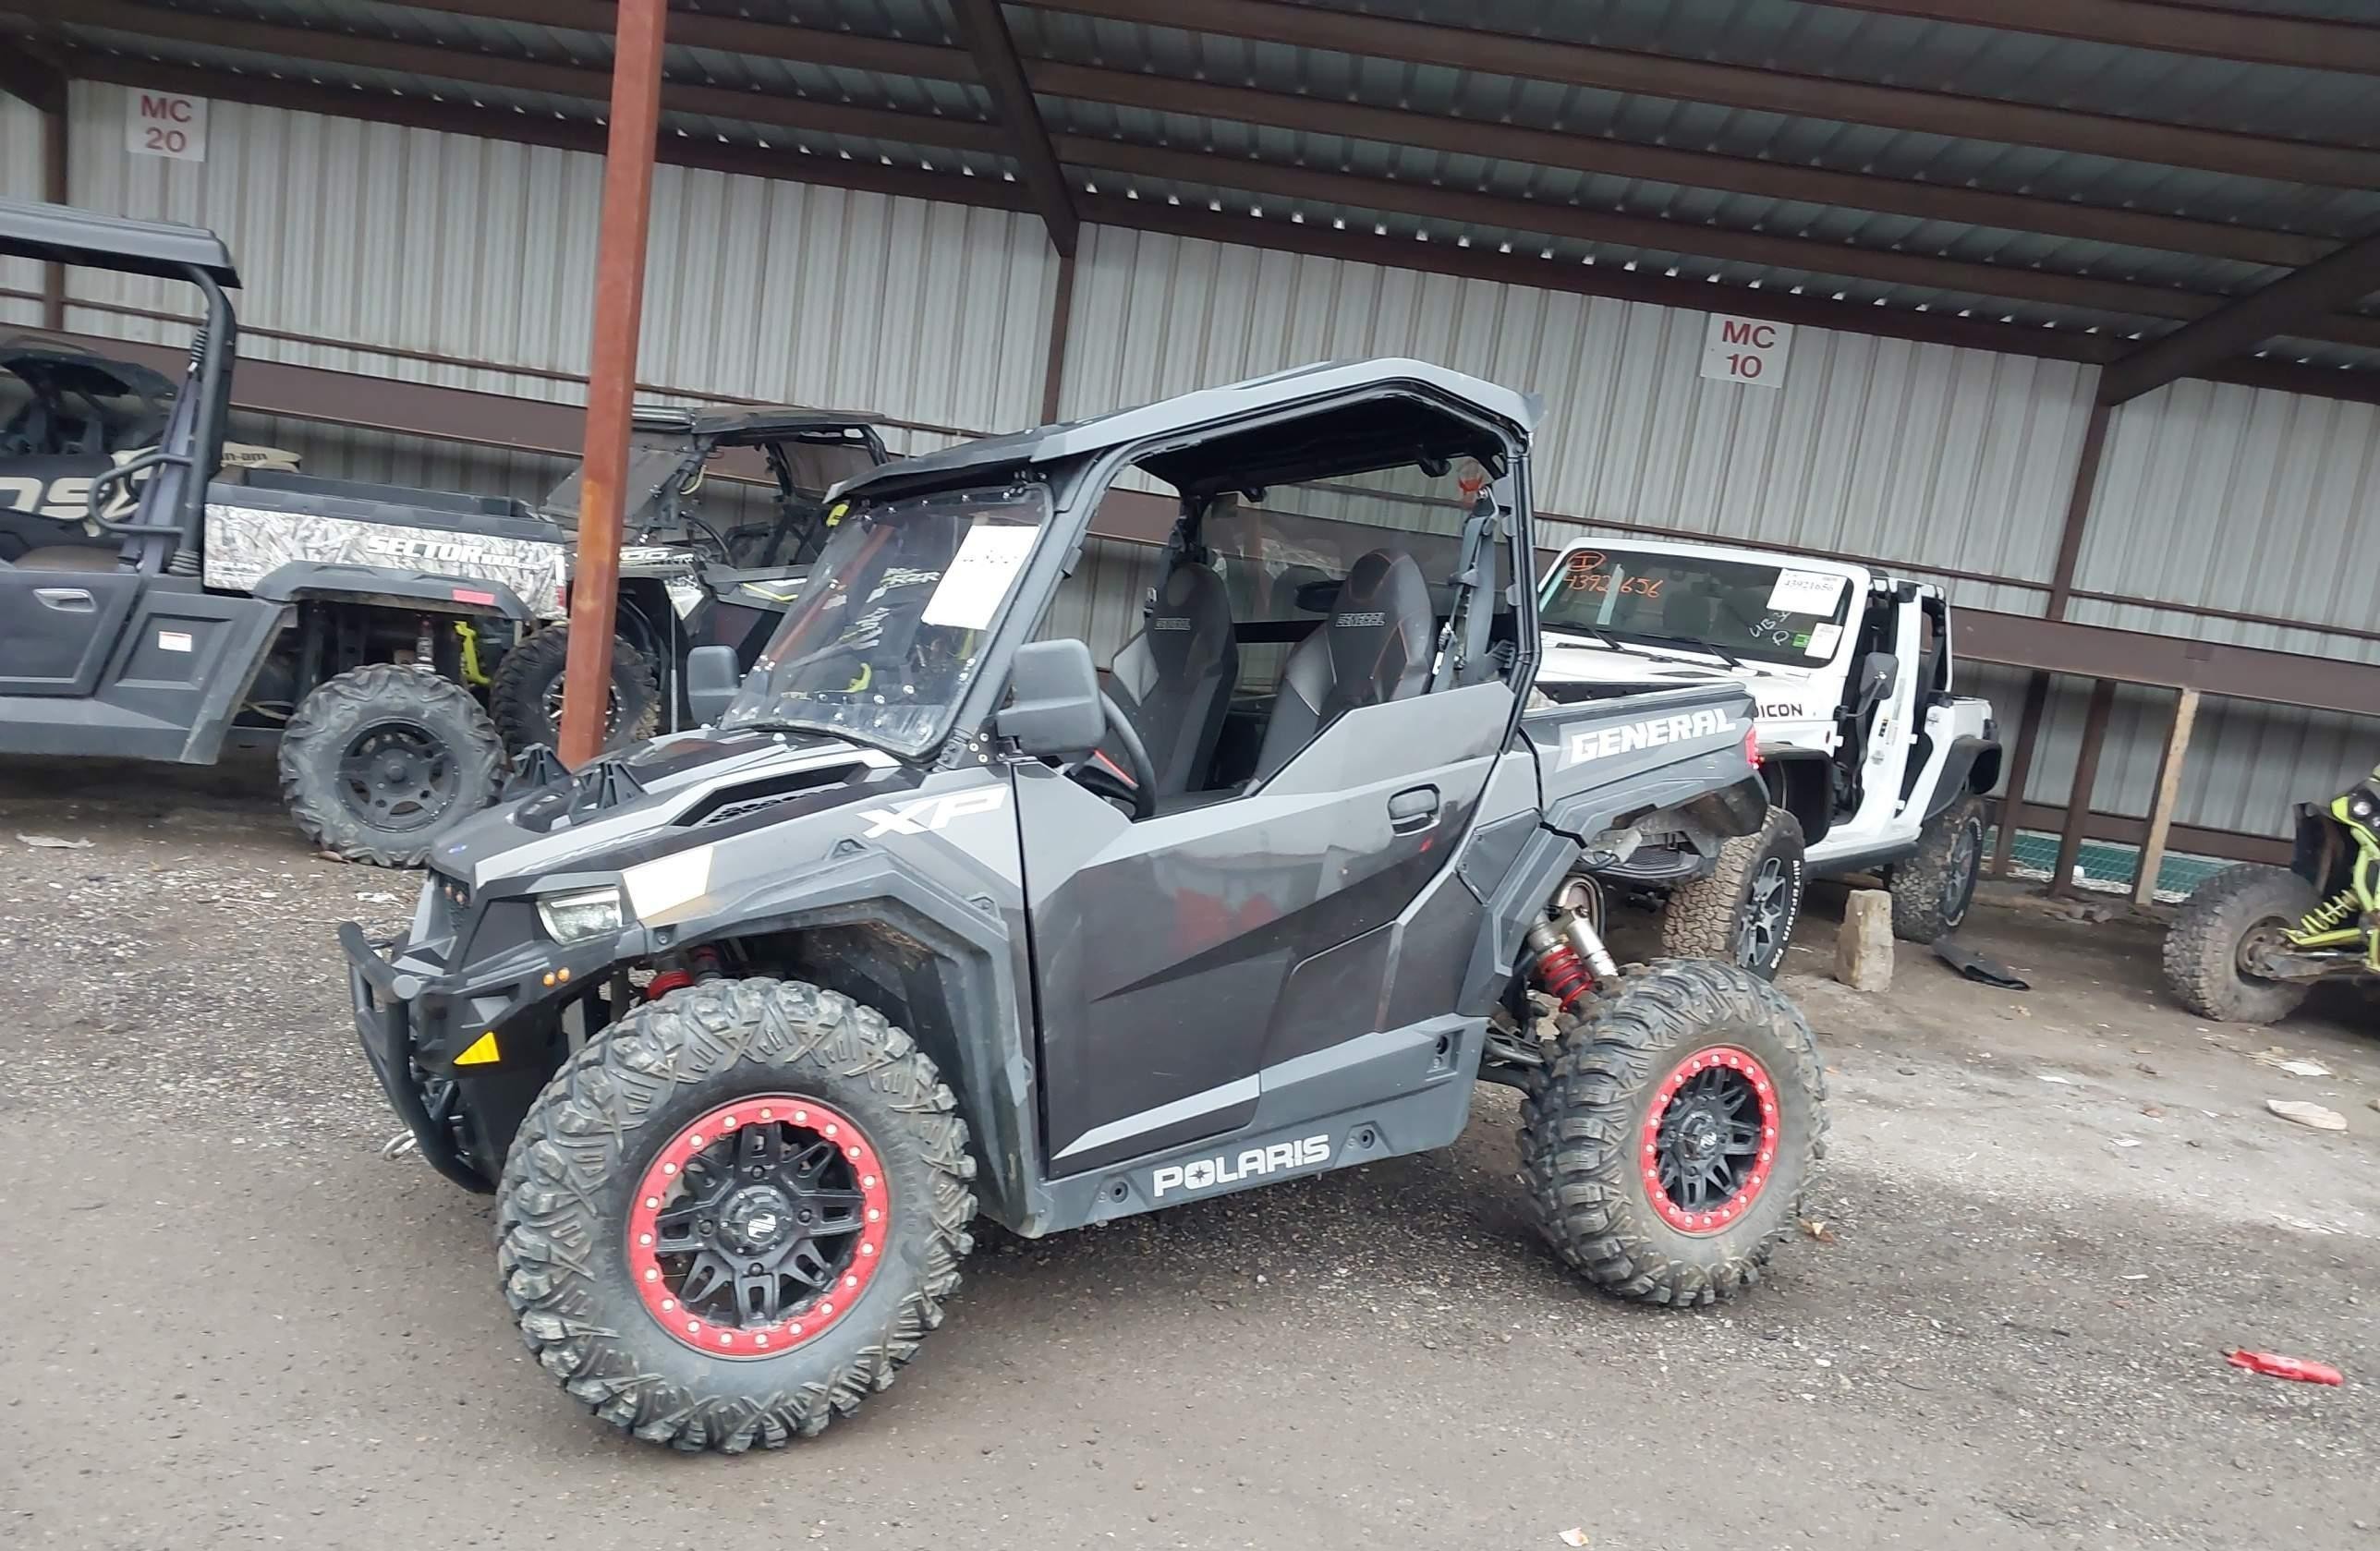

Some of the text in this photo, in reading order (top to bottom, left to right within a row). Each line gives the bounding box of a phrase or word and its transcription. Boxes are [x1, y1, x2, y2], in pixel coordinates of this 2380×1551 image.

[140, 94, 192, 123] MC
[145, 126, 187, 153] 20
[1721, 320, 1776, 349] MC
[1726, 353, 1763, 379] 10
[224, 451, 268, 462] n-am
[366, 535, 483, 563] SECTOR
[1563, 575, 1664, 598] 4392656
[1754, 703, 1803, 719] ICON
[1570, 708, 1737, 764] GENERAL
[855, 782, 1009, 839] XP
[1152, 1133, 1331, 1198] POLARIS
